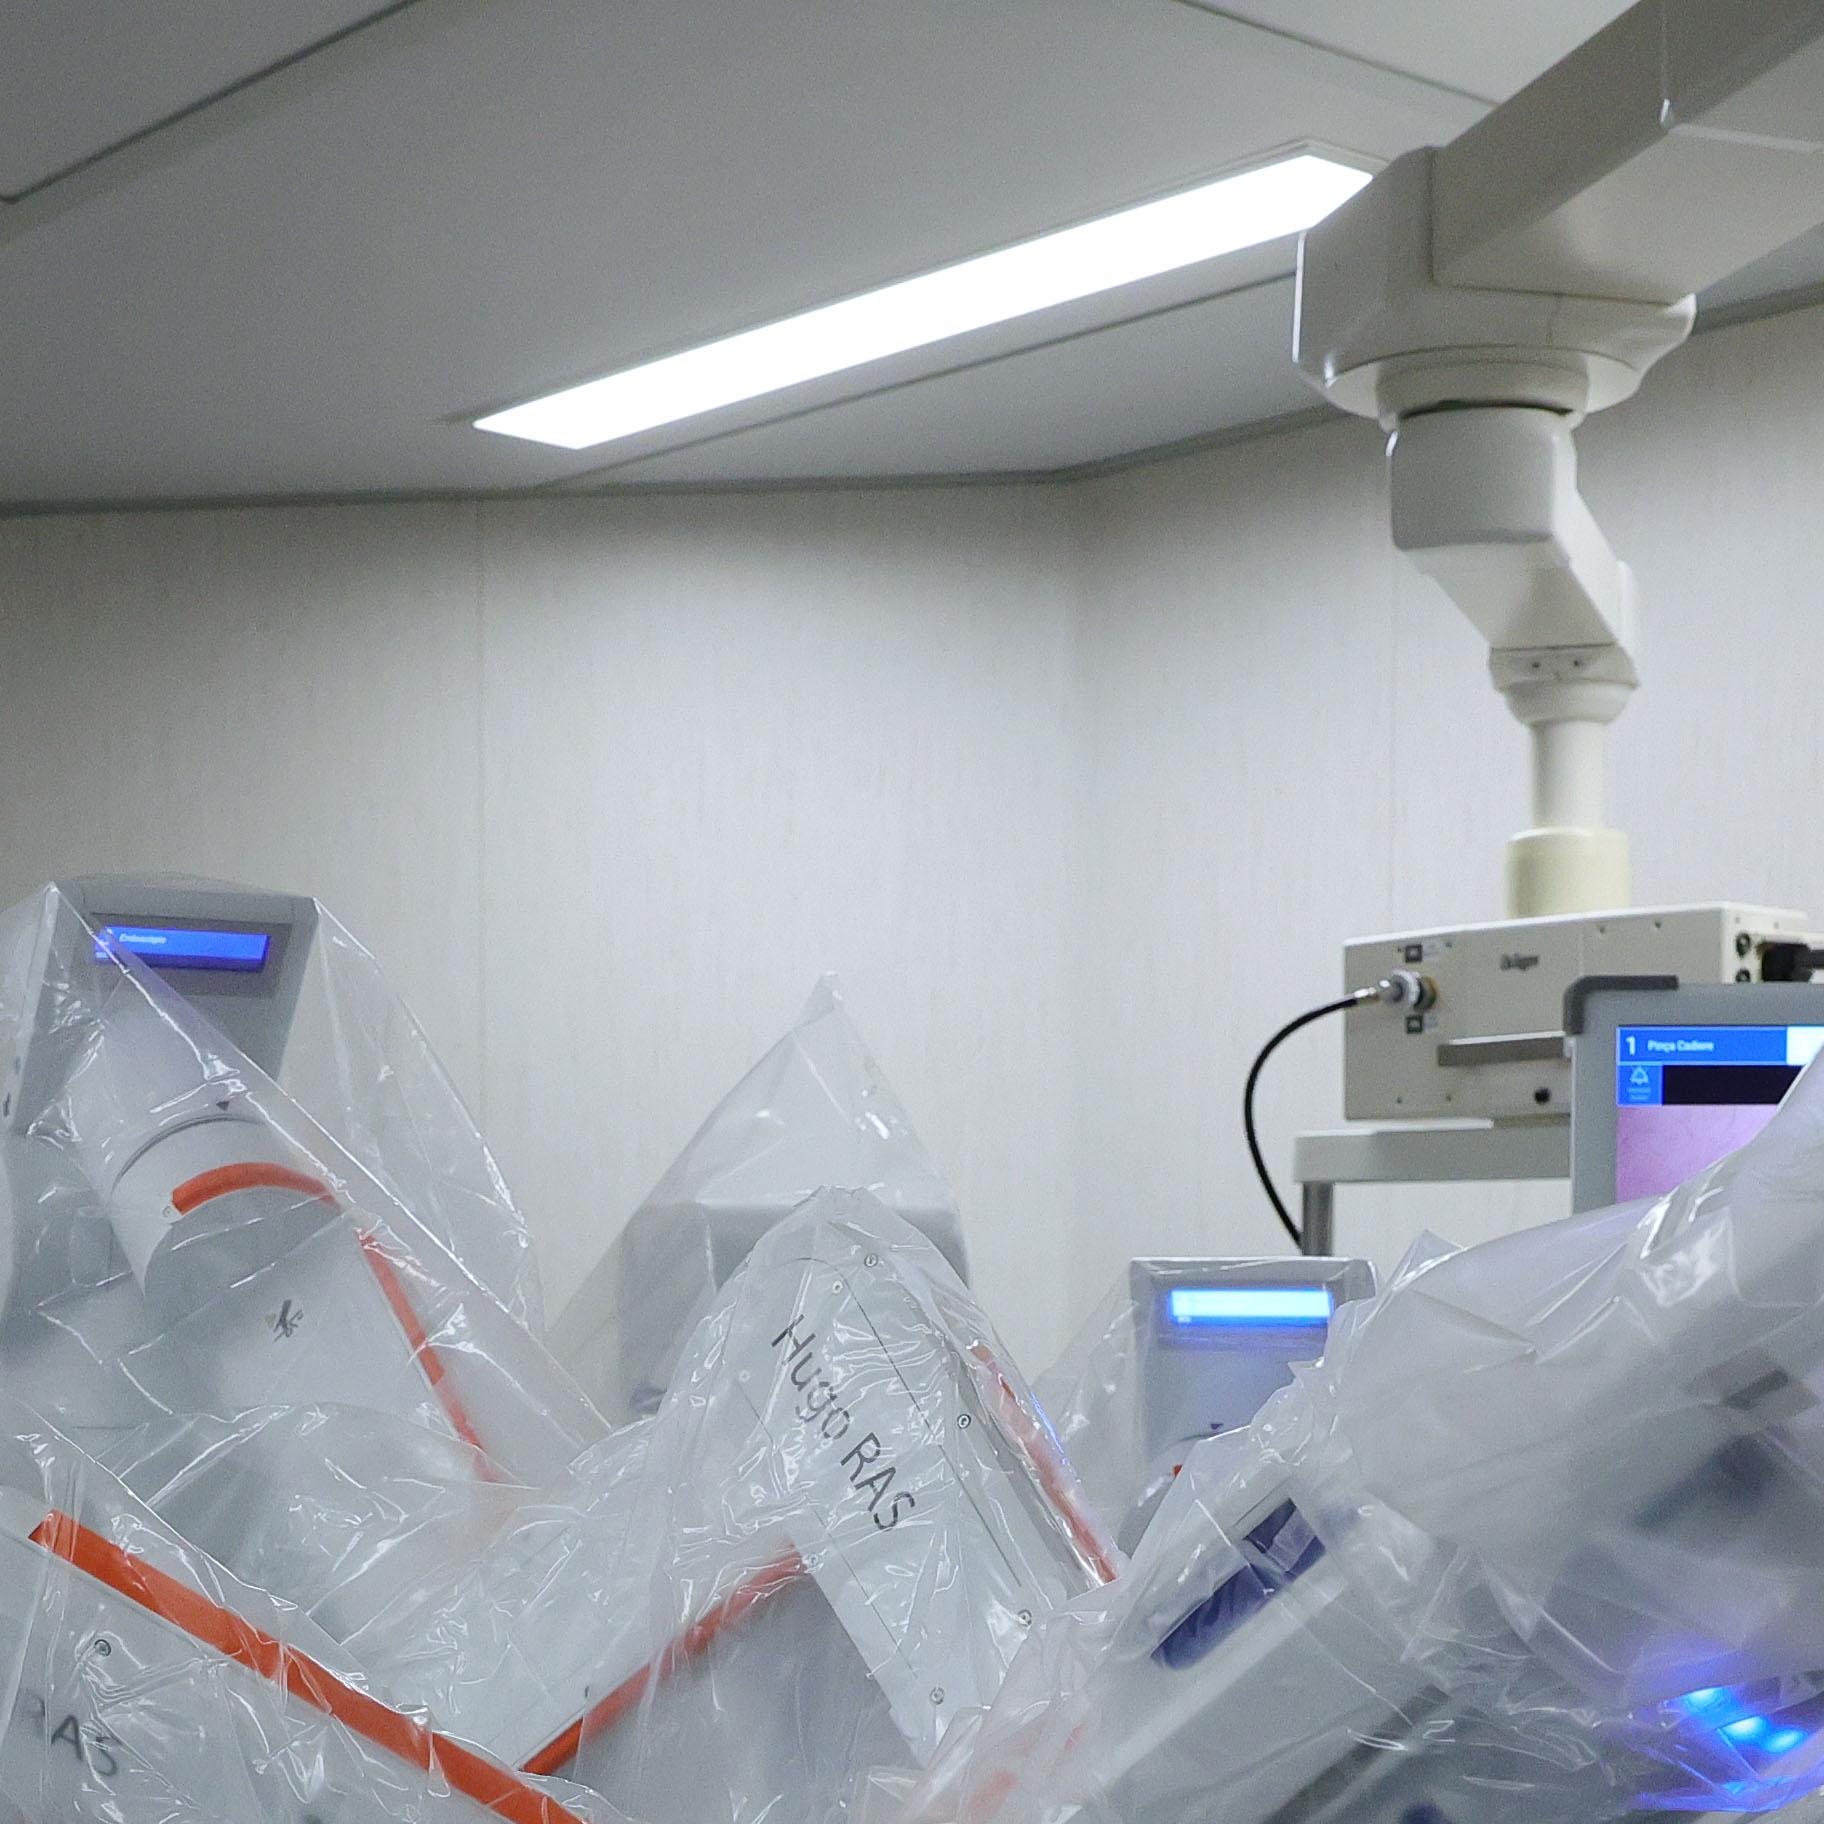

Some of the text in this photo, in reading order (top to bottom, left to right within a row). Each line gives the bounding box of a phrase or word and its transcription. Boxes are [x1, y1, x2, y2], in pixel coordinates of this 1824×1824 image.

[1625, 1036, 1636, 1055] 1
[771, 1314, 916, 1532] Hugo RAS
